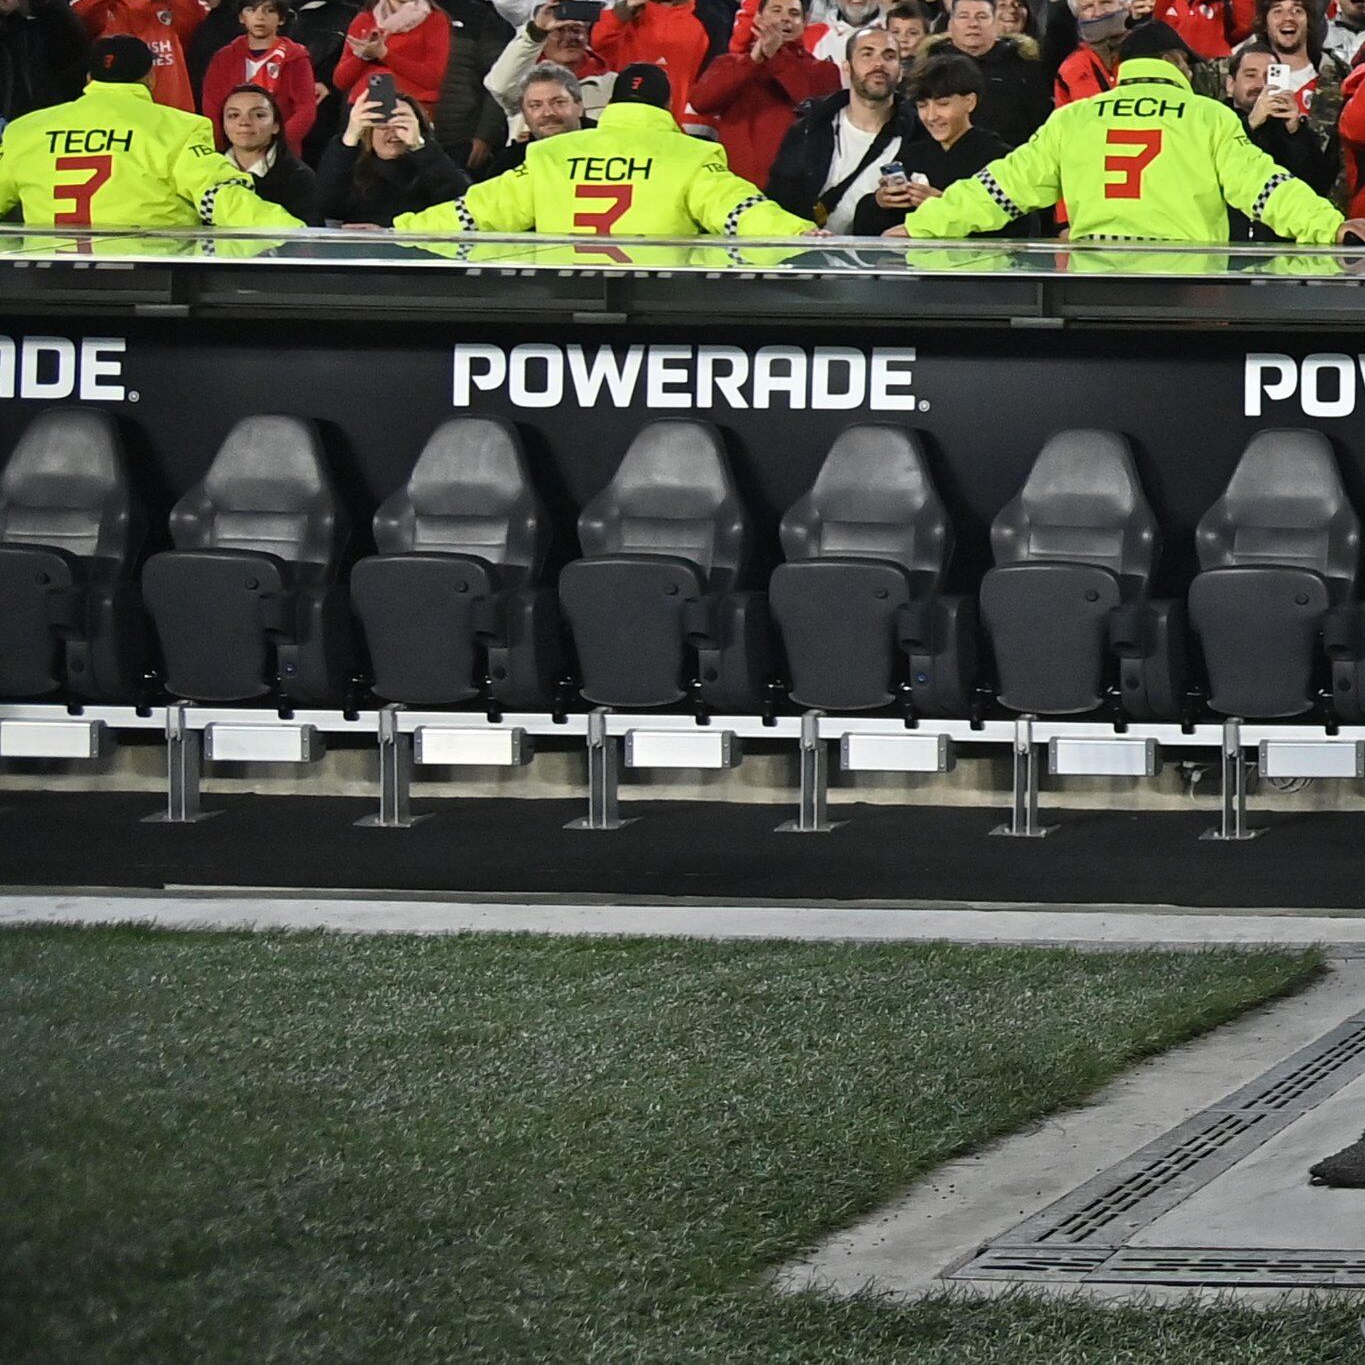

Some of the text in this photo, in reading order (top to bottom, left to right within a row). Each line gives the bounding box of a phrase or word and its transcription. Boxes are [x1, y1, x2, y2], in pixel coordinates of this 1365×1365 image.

[1094, 97, 1185, 119] TECH
[46, 129, 133, 154] TECH
[567, 157, 653, 181] TECH
[452, 342, 917, 411] POWERADE
